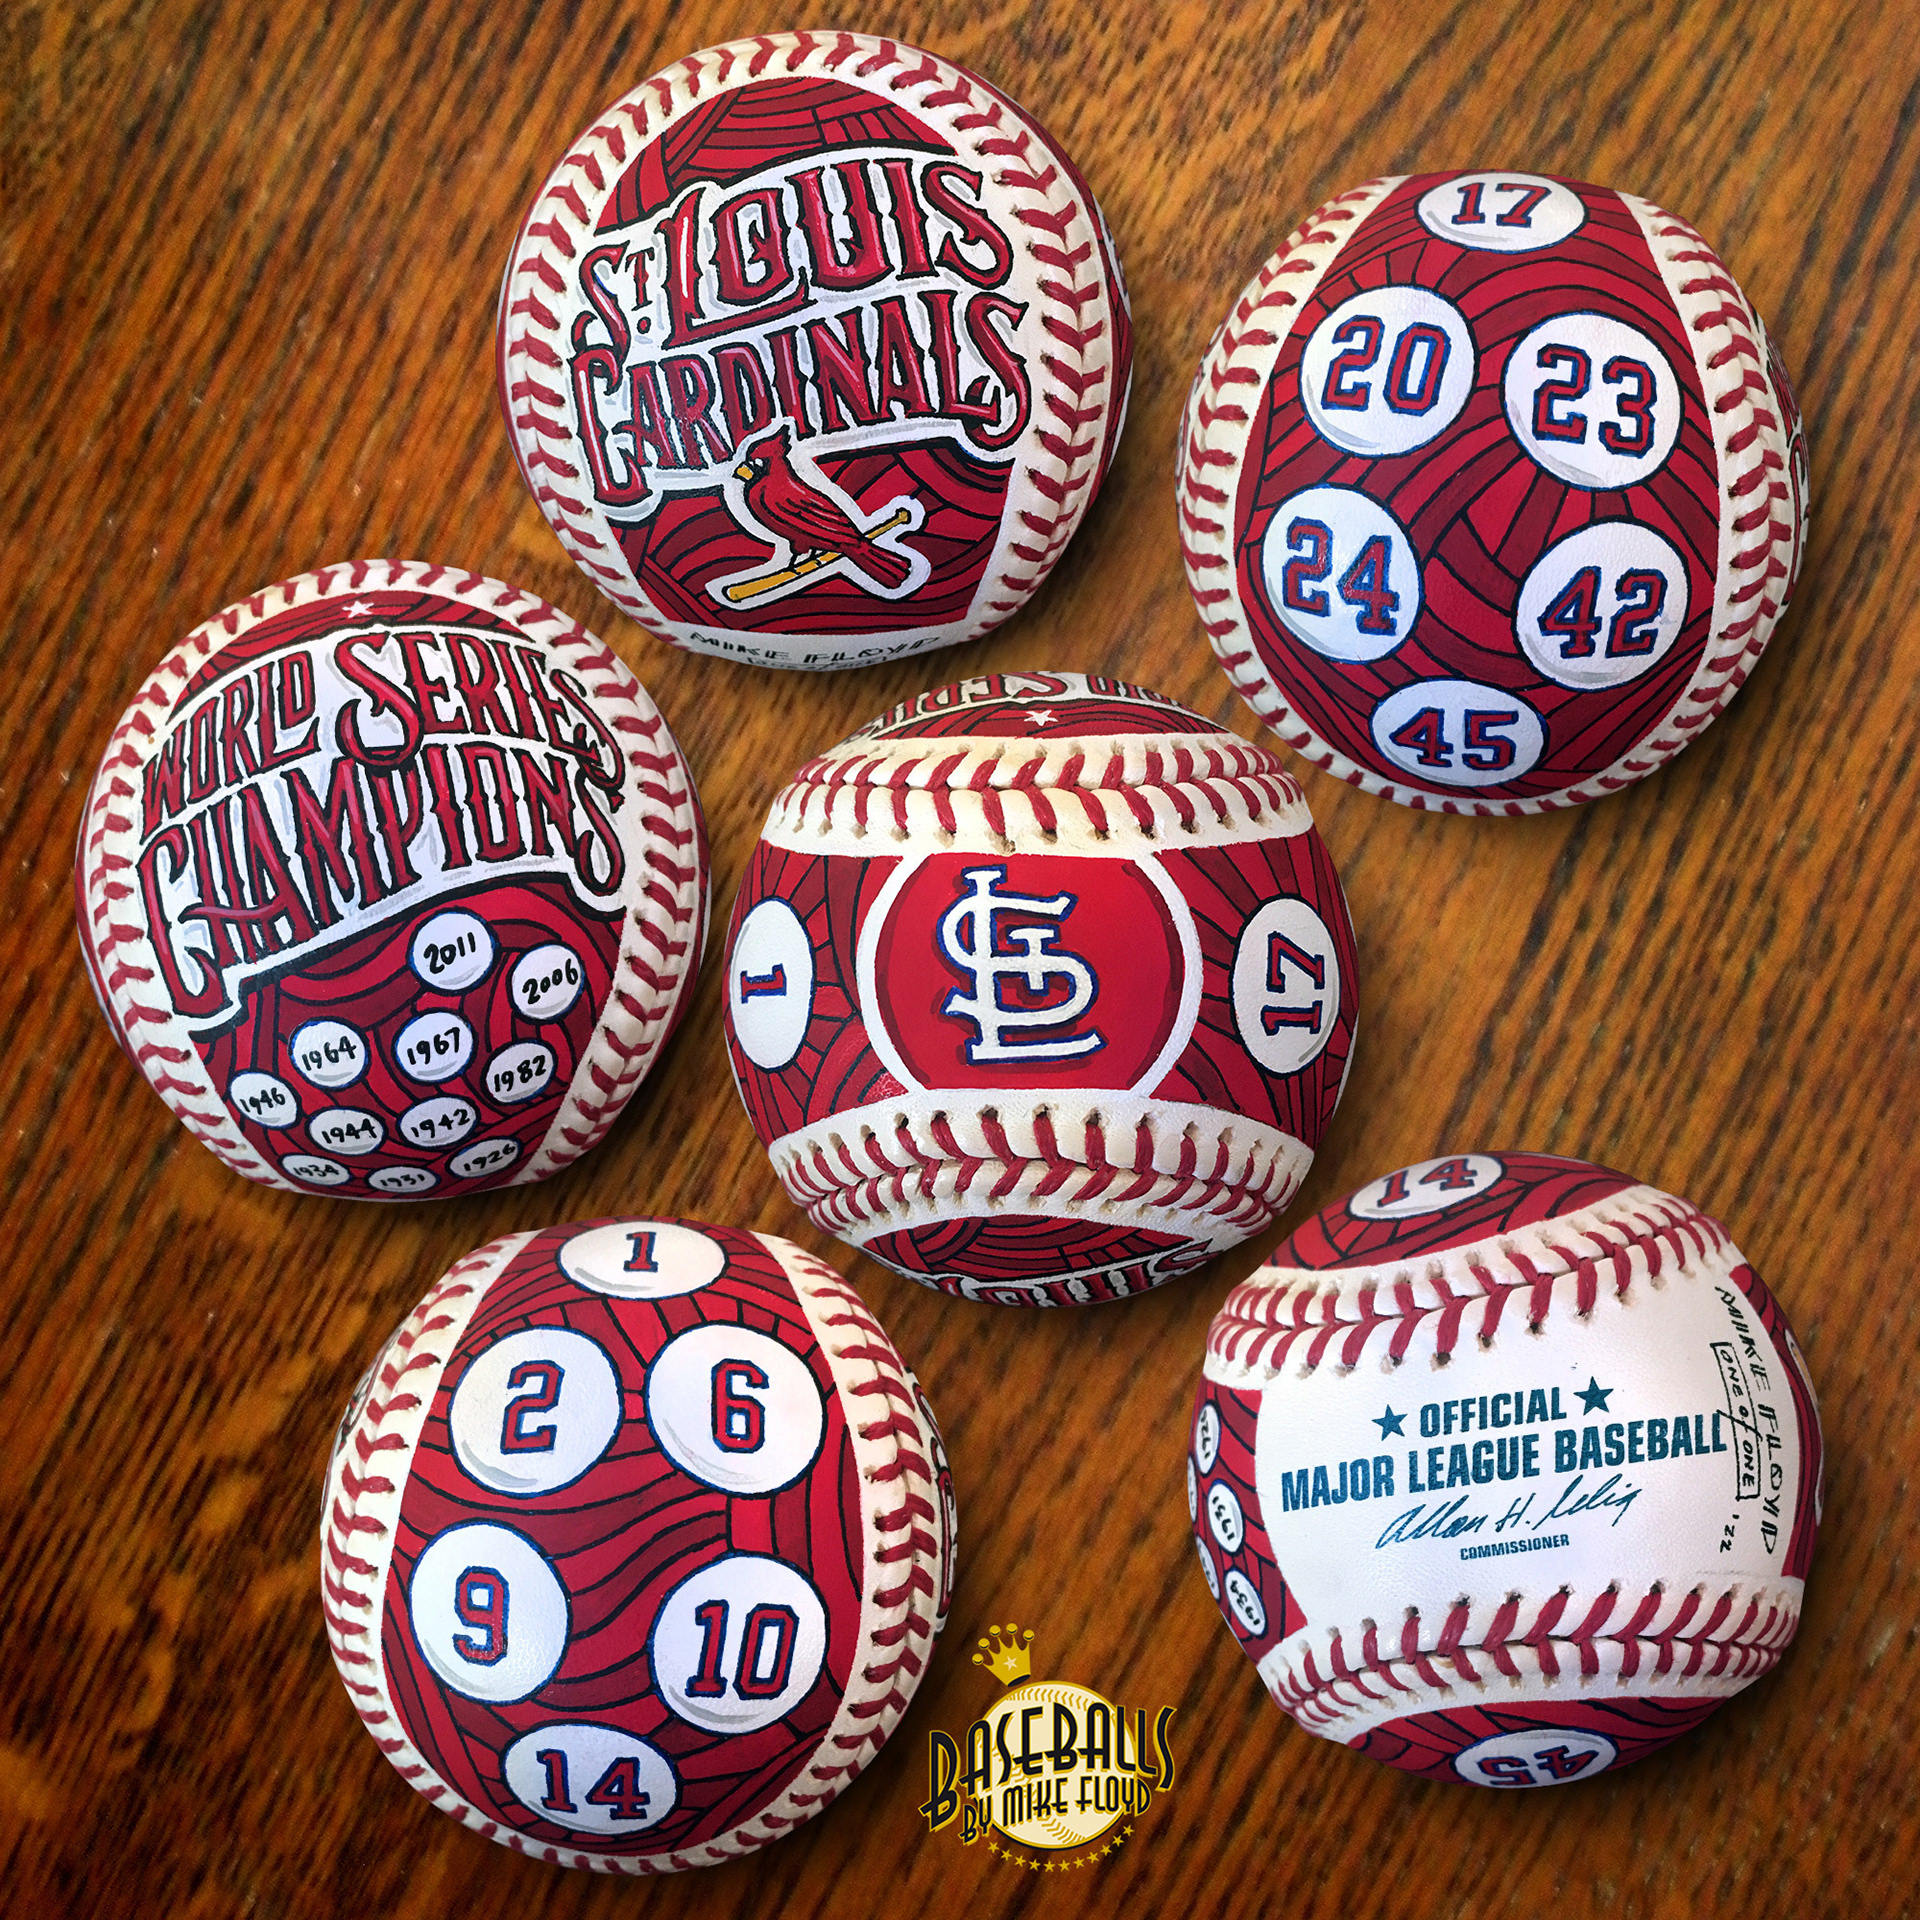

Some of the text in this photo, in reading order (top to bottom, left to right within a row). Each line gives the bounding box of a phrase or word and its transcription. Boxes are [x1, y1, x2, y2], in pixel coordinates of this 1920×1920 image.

[1451, 181, 1552, 229] 17
[656, 157, 1014, 352] LOUIS
[1321, 315, 1452, 417] 20
[567, 291, 1030, 507] CARDINALS
[1532, 344, 1657, 459] 23
[1281, 516, 1400, 637] 24
[1538, 566, 1668, 660] 42
[690, 632, 792, 661] MIKE
[803, 637, 941, 664] FLOYD
[140, 630, 626, 845] WORLD SERIES
[1389, 706, 1520, 771] 45
[136, 742, 628, 1018] CHAMPIONS
[423, 932, 476, 974] 2011
[522, 958, 579, 1004] 2006
[741, 964, 787, 1005] 1
[1261, 932, 1326, 1036] 17
[301, 1036, 357, 1071] 1964
[407, 1027, 461, 1065] 1967
[493, 1054, 547, 1093] 1982
[240, 1088, 285, 1115] 1946
[411, 1108, 470, 1139] 1942
[321, 1118, 376, 1144] 1944
[292, 1163, 340, 1180] 1934
[379, 1174, 426, 1188] 1931
[463, 1143, 517, 1172] 1926
[1378, 1157, 1478, 1208] 14
[623, 1231, 659, 1273] 1
[500, 1359, 564, 1454] 2
[710, 1358, 770, 1453] 6
[1420, 1386, 1566, 1438] OFFICIAL
[1715, 1286, 1783, 1555] MIKE FLOYD
[1720, 1349, 1744, 1398] ONE
[1742, 1439, 1755, 1488] ONE
[1281, 1411, 1728, 1512] MAJOR LEAGUE BASEBALL
[1212, 1496, 1235, 1541] 1931
[1460, 1533, 1570, 1561] COMMISSIONER
[453, 1566, 510, 1666] 9
[1230, 1579, 1261, 1626] 1934
[685, 1599, 800, 1701] 10
[536, 1749, 650, 1820] 14
[1477, 1744, 1600, 1786] 45
